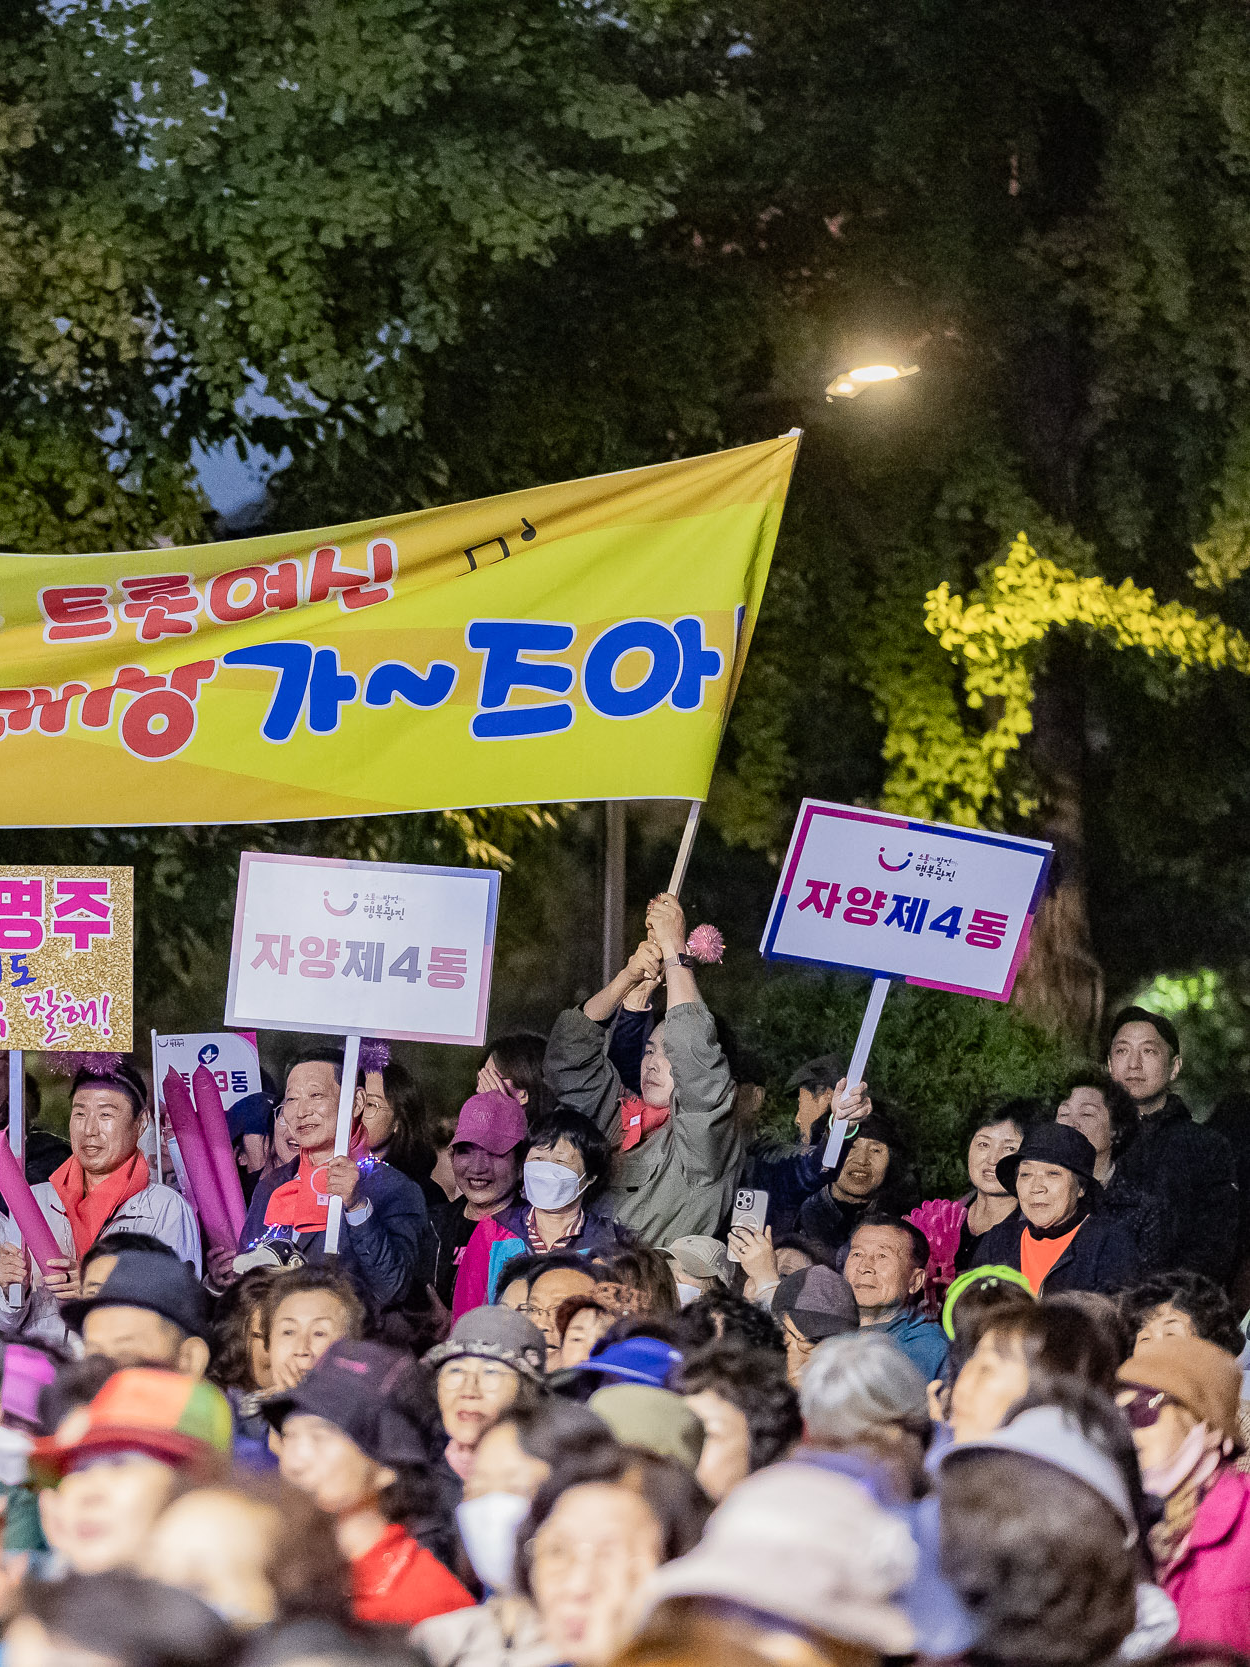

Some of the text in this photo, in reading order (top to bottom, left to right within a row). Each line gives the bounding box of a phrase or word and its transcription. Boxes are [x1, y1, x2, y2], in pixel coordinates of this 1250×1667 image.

[40, 538, 398, 644] 트롯여신
[223, 606, 746, 744] 가~즈아
[915, 864, 956, 882] 행복광진
[363, 904, 405, 920] 행복광진
[797, 879, 1009, 950] 자양제4동
[250, 933, 468, 989] 자양제4동
[24, 986, 112, 1046] 잘해!
